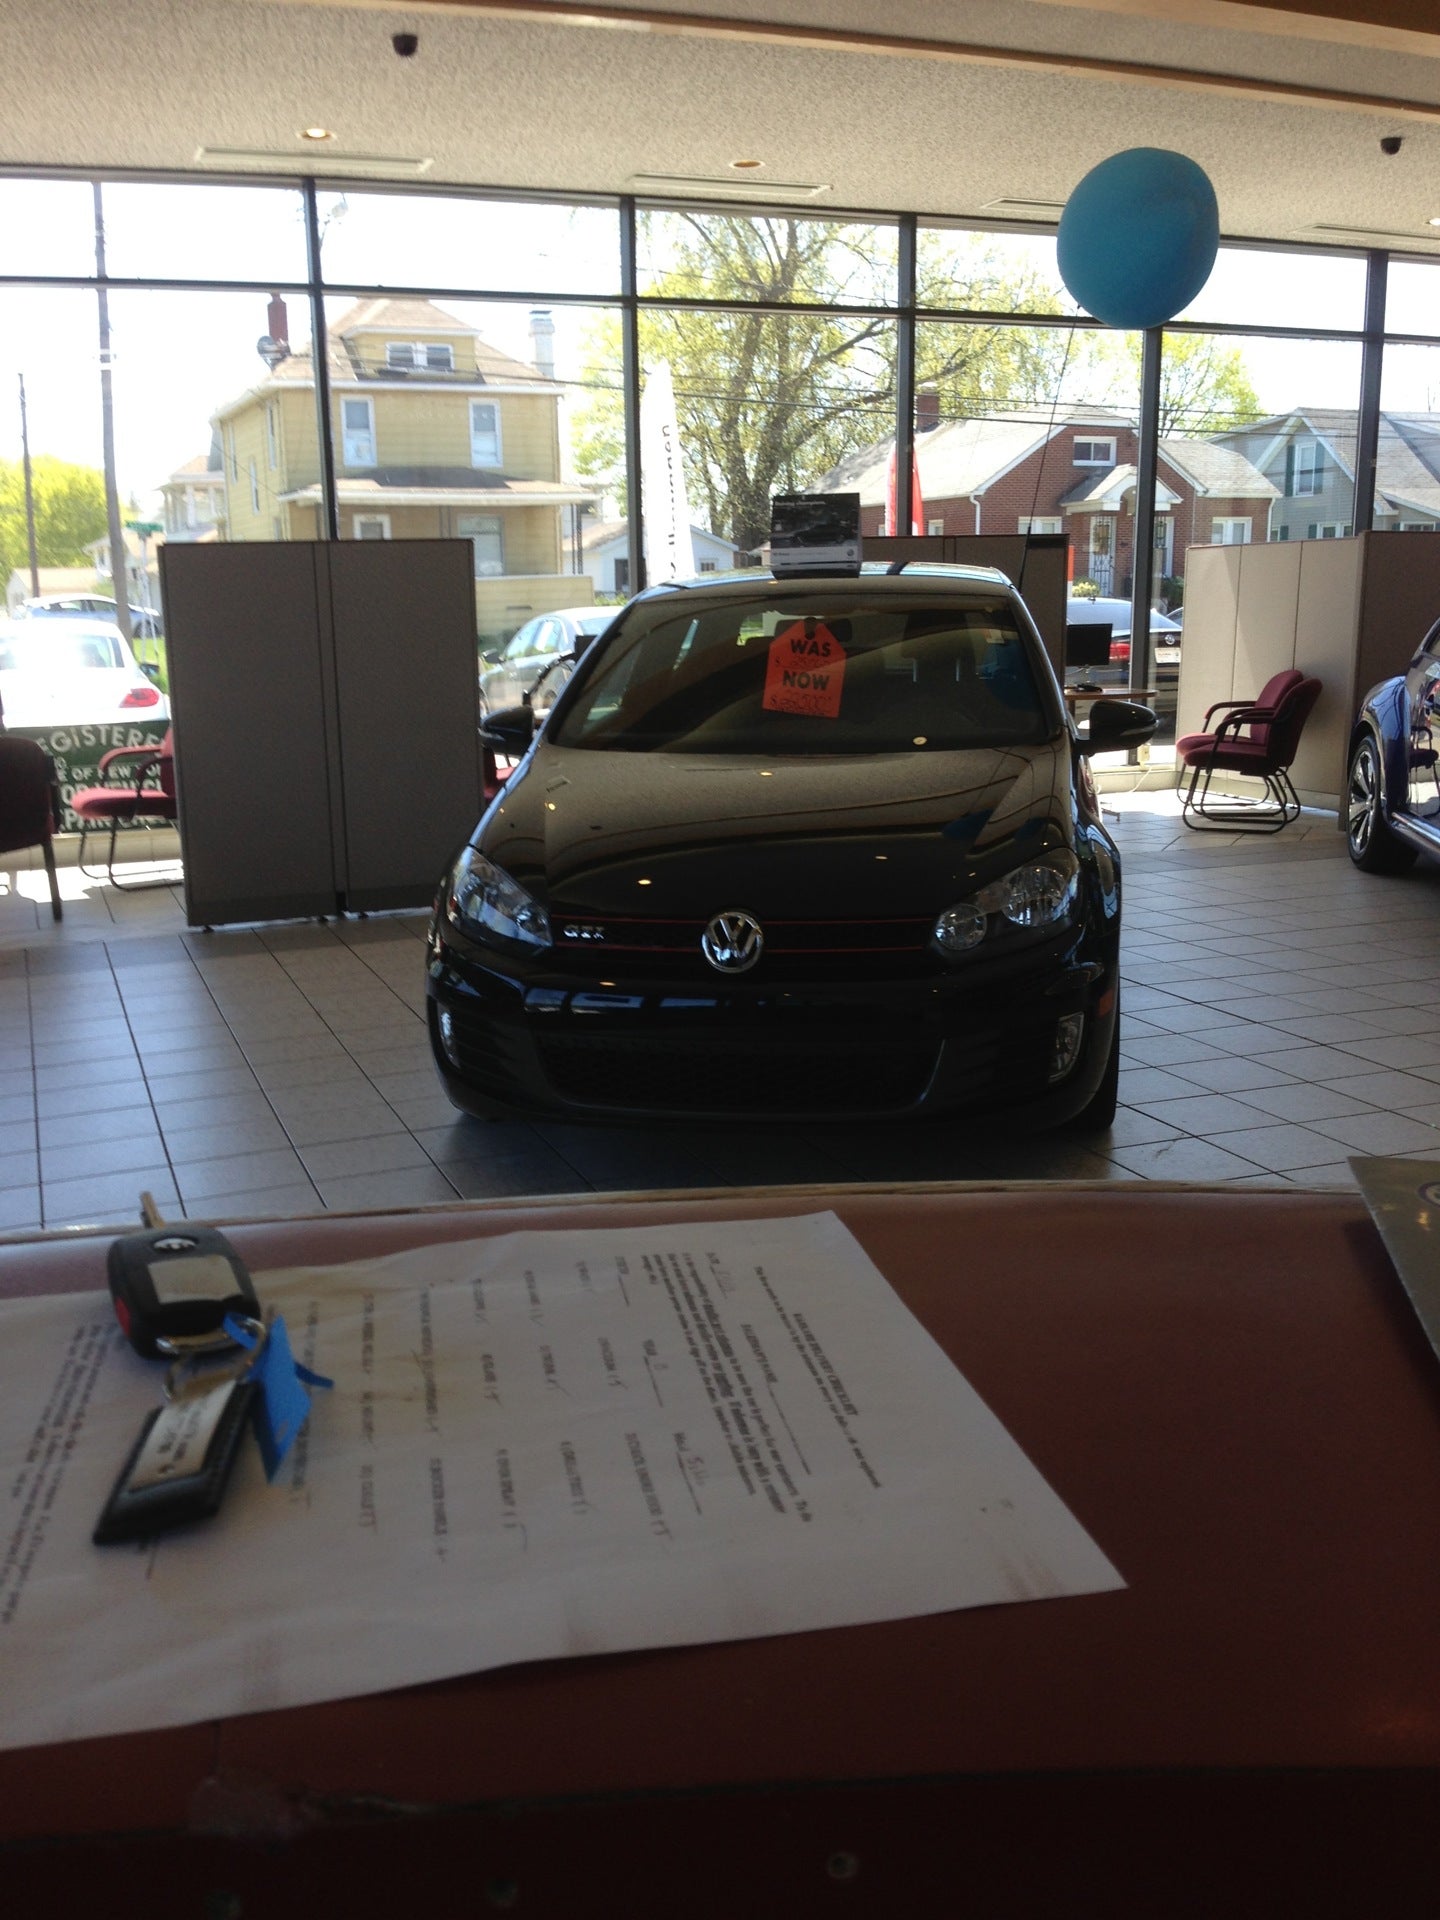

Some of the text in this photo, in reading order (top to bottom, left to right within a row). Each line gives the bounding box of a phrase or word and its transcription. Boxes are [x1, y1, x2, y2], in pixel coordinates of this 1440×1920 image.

[790, 639, 831, 657] WAS
[783, 669, 830, 691] NOW
[36, 724, 167, 758] EGISTERE
